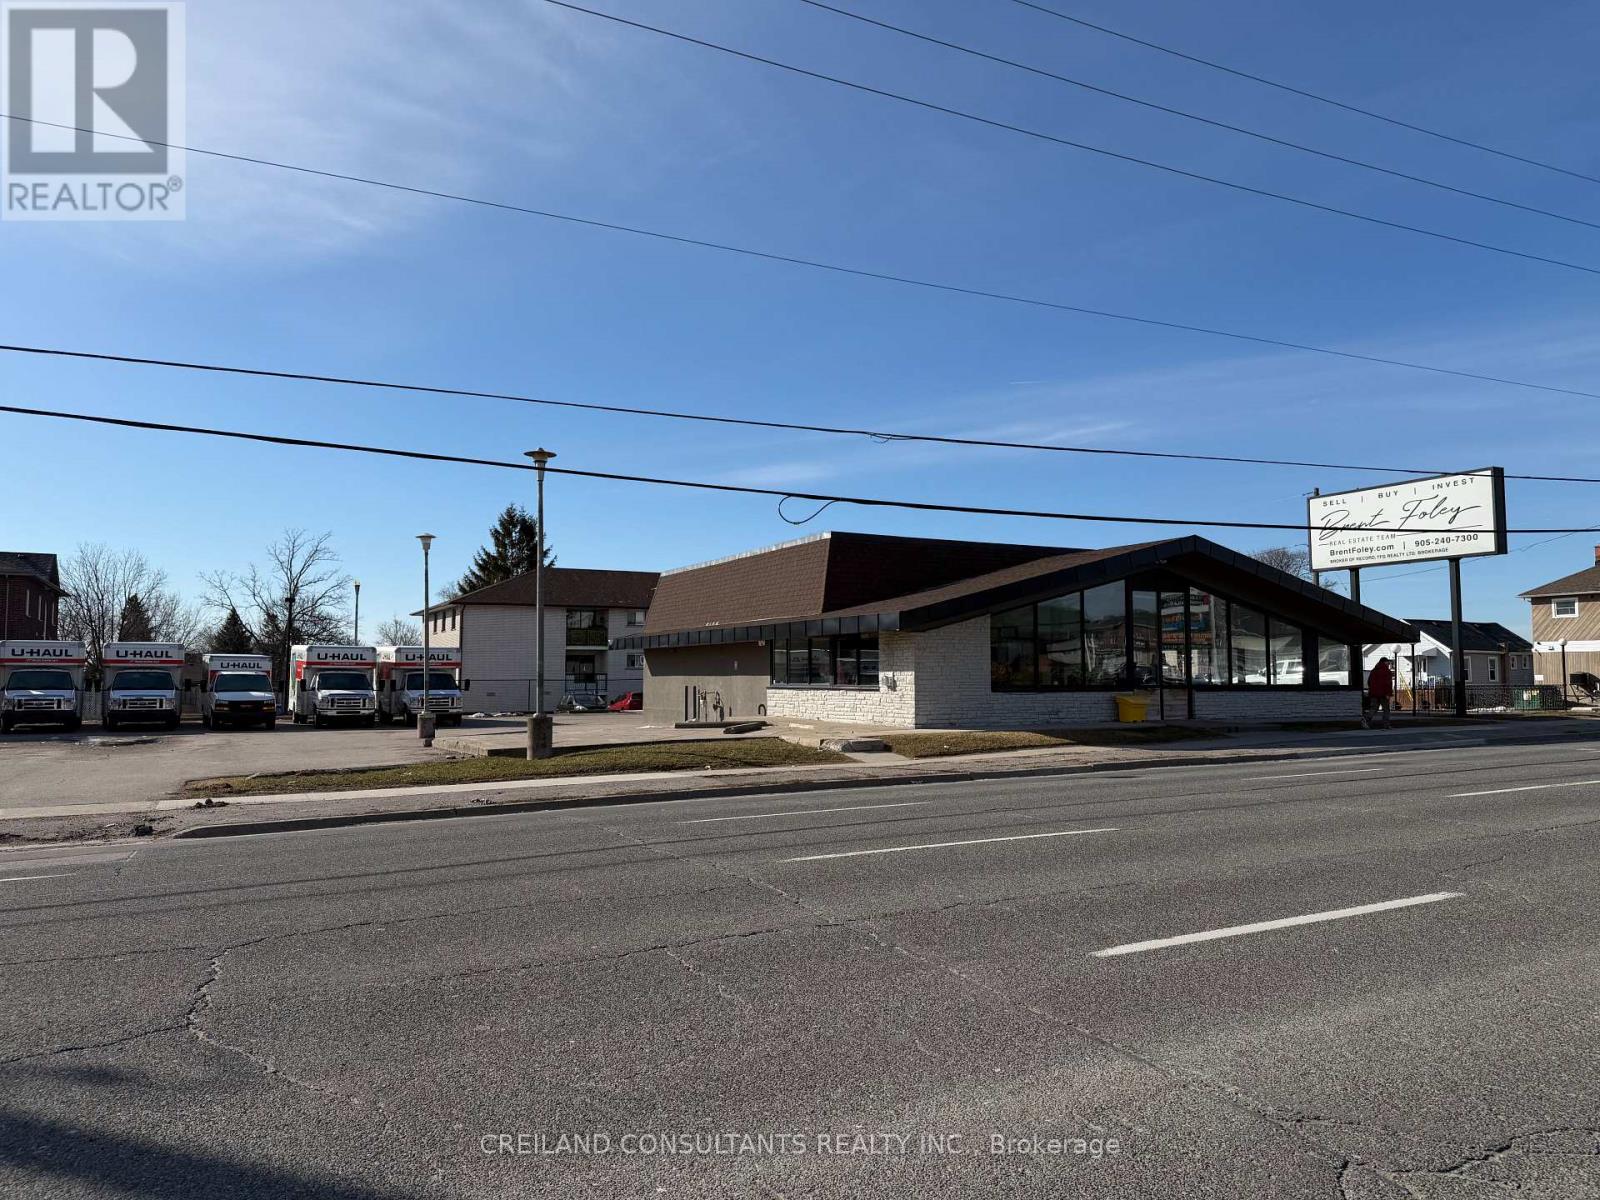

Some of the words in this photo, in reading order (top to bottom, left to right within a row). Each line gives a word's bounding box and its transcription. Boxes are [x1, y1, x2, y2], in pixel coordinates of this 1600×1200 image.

[1323, 498, 1347, 507] SELL
[1378, 490, 1399, 499] BUY
[1432, 477, 1475, 491] INVEST
[1318, 508, 1390, 541] Brent
[1399, 494, 1481, 530] Foley
[1348, 536, 1374, 545] ESTATE
[1376, 533, 1396, 542] TEAM
[1330, 543, 1394, 557] BrentFoley.com
[1414, 533, 1479, 548] 905-240-7300
[11, 648, 73, 657] U-HAUL
[116, 650, 173, 658] U-HAUL
[317, 652, 367, 661] U-HAUL
[220, 662, 262, 670] U-HAUL
